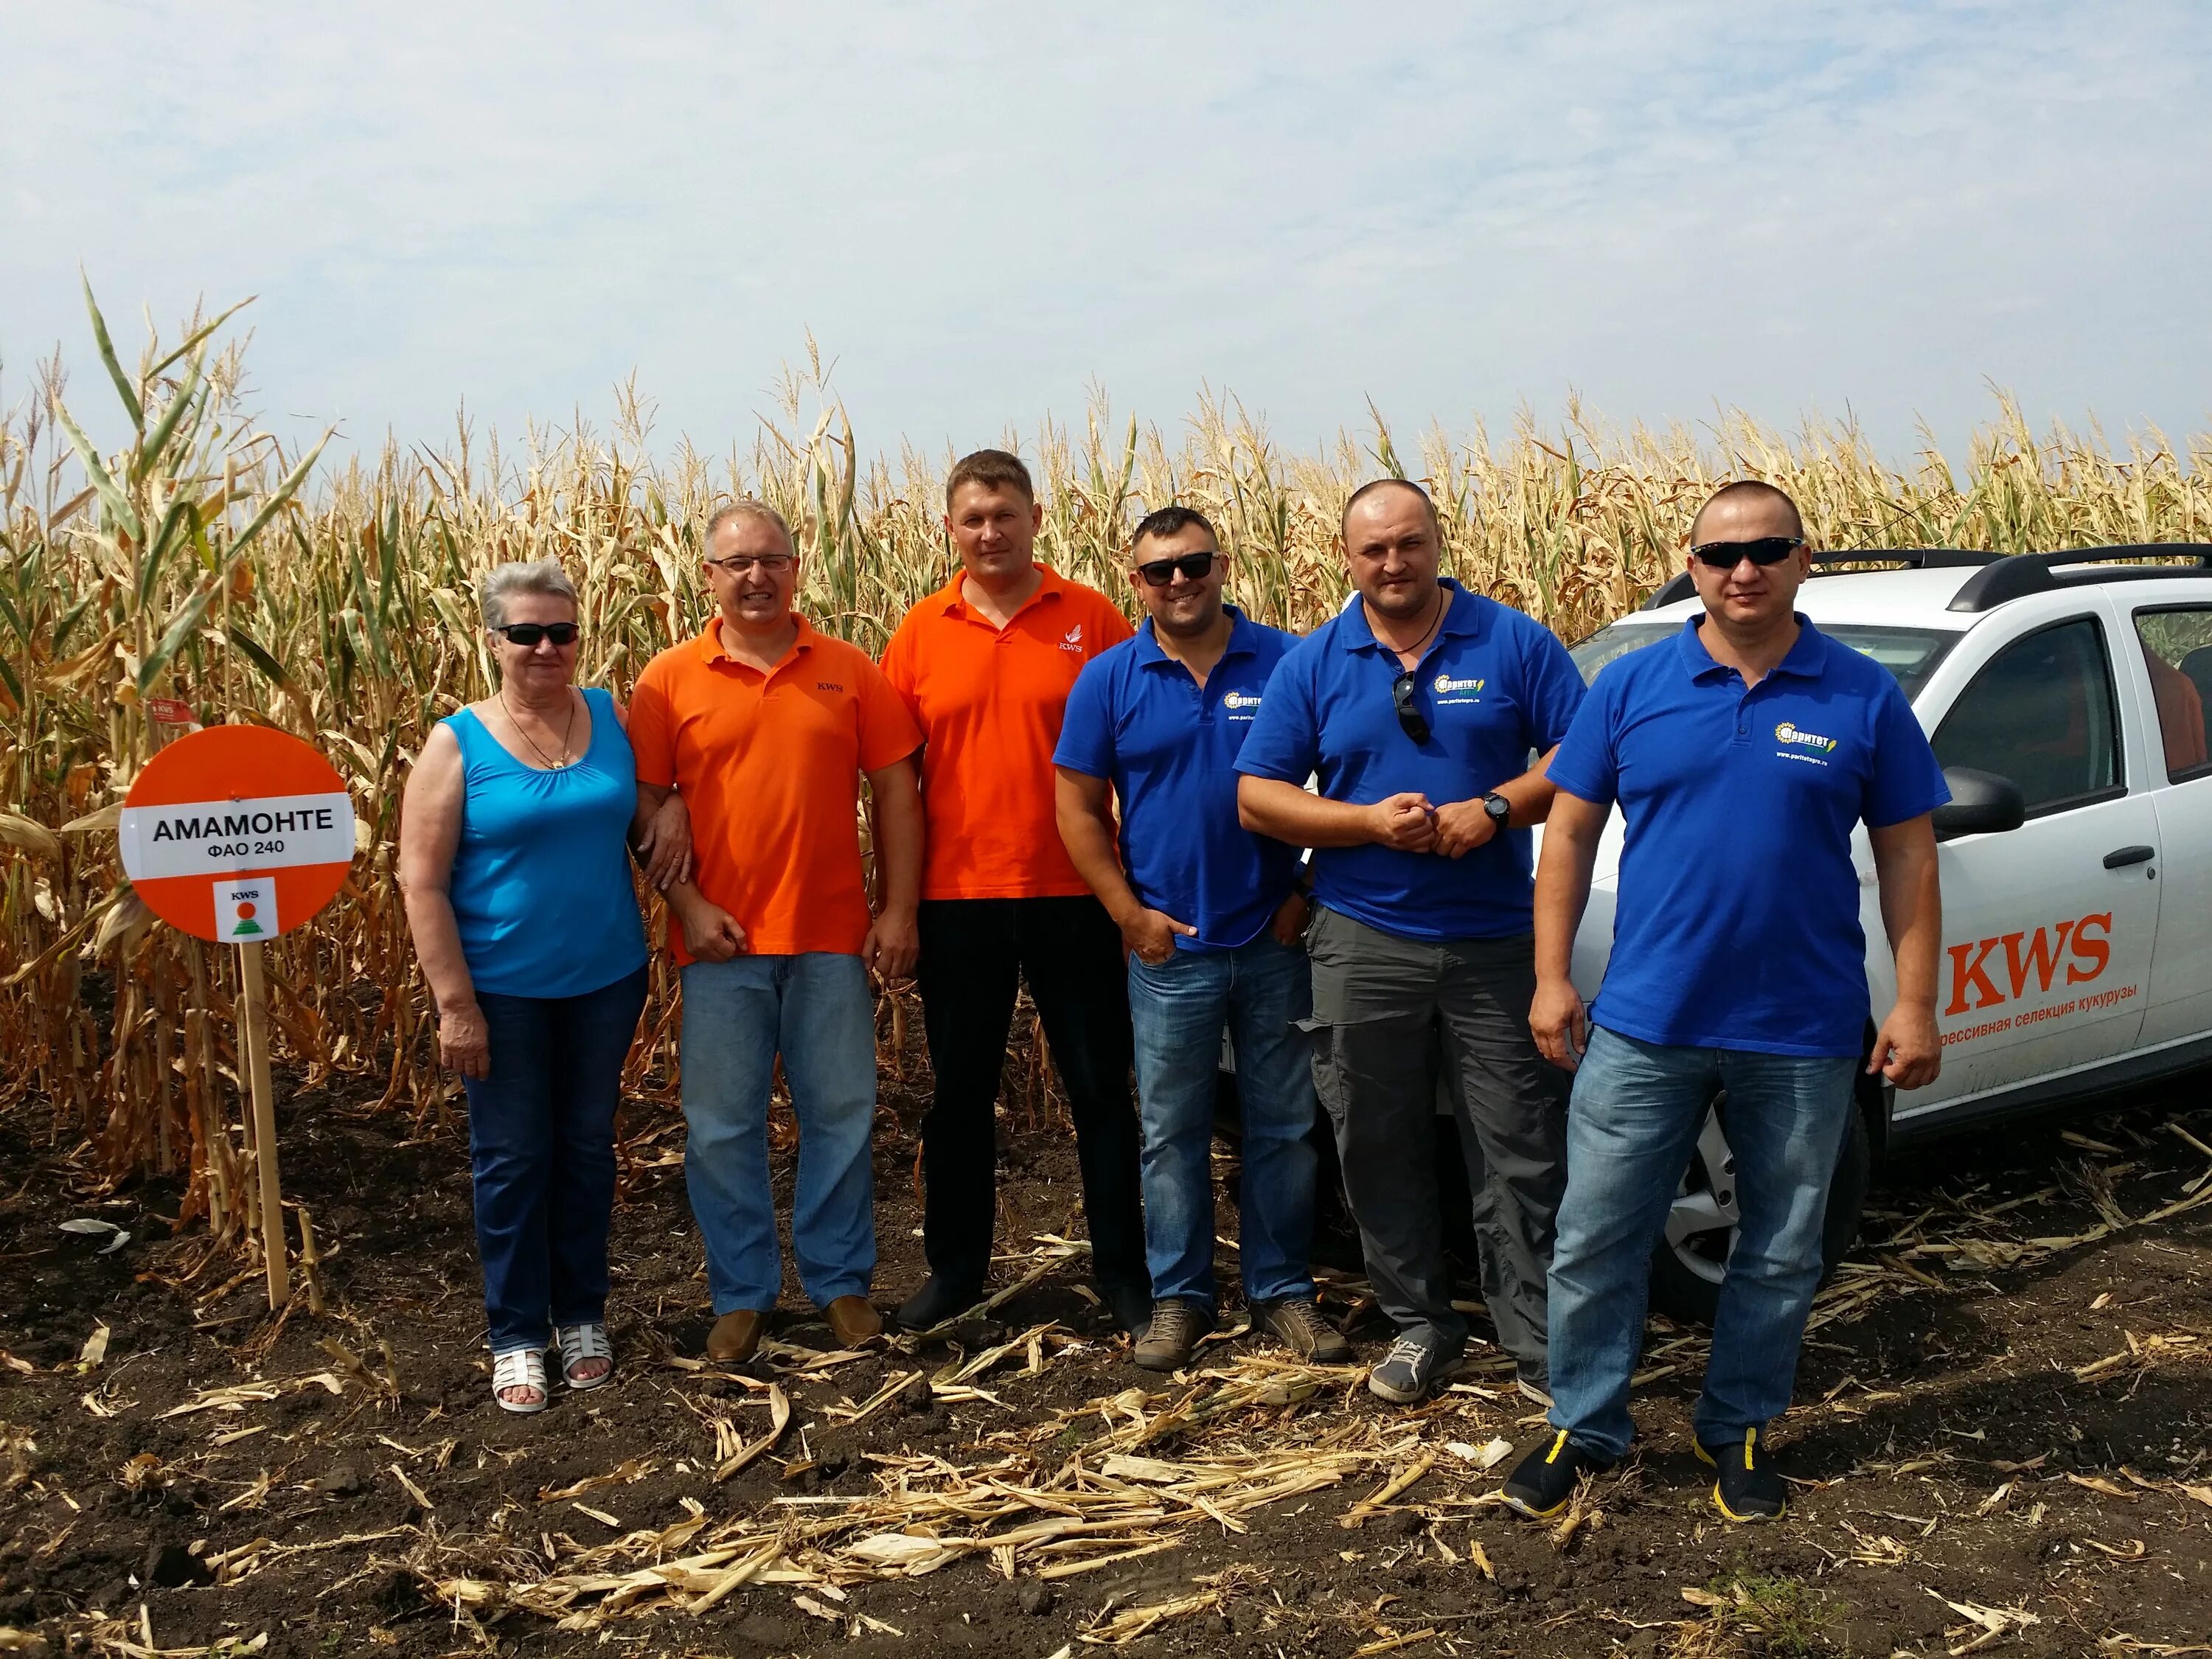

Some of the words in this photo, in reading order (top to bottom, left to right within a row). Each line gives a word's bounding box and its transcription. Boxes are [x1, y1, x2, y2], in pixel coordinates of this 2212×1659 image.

[1060, 642, 1082, 653] KWS
[817, 682, 844, 693] KWS
[1776, 752, 1828, 767] www.paritetagro.ru
[153, 808, 333, 841] АМАМОНТЕ
[208, 843, 248, 858] ФАО
[254, 840, 285, 855] 240
[231, 890, 259, 901] KWS
[1945, 912, 2112, 1017] KWS
[2015, 1000, 2076, 1028] селекция
[2079, 984, 2138, 1013] кукурузы
